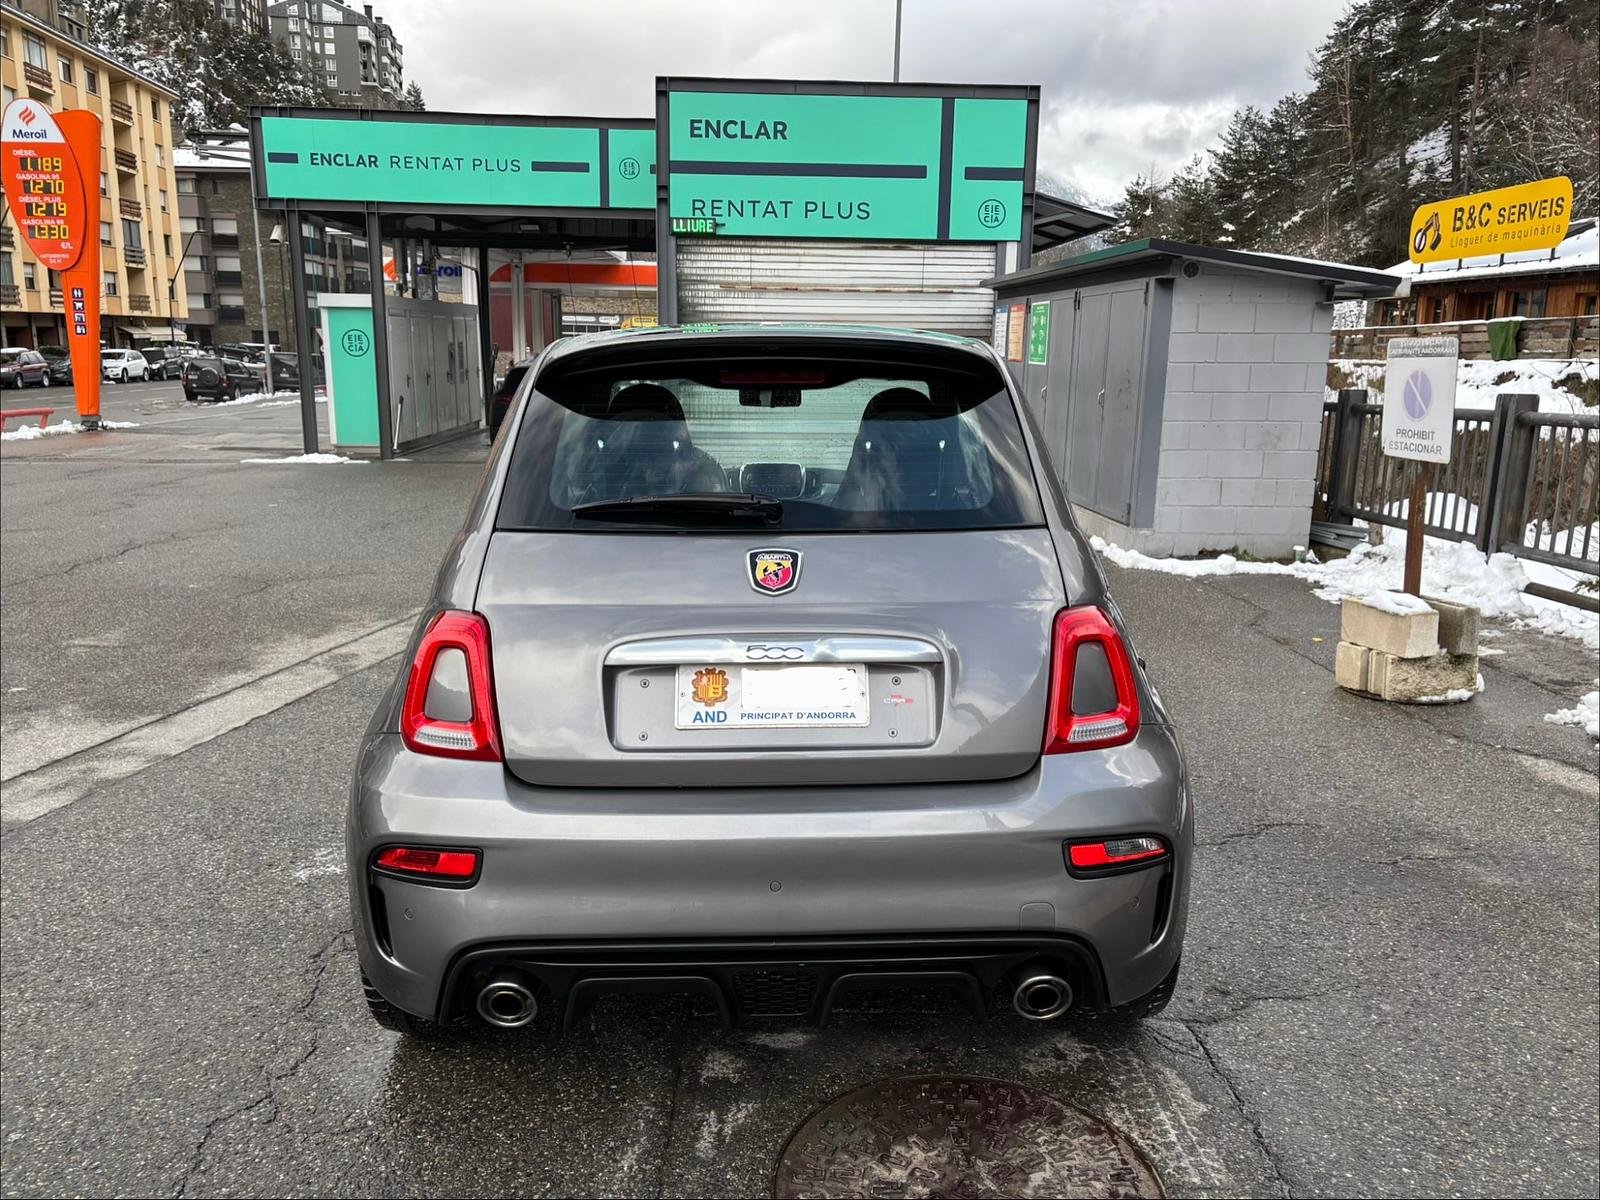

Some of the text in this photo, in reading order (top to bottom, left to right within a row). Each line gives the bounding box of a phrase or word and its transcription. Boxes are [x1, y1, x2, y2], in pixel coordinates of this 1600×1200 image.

[12, 129, 47, 139] Meroil
[690, 119, 788, 140] ENCLAR
[309, 152, 521, 172] ENCLAR RENTAT PLUS
[691, 199, 872, 220] RENTAT PLUS
[1452, 197, 1565, 233] B&C SERVEIS
[673, 219, 714, 232] LLIURE
[1450, 223, 1561, 249] Lloguer de maquinària
[1395, 428, 1436, 440] PROHIBIT
[1388, 440, 1443, 456] ESTACIONAR
[746, 645, 805, 660] 500
[692, 711, 857, 724] AND PRINCIPAT D'ANDORRA
